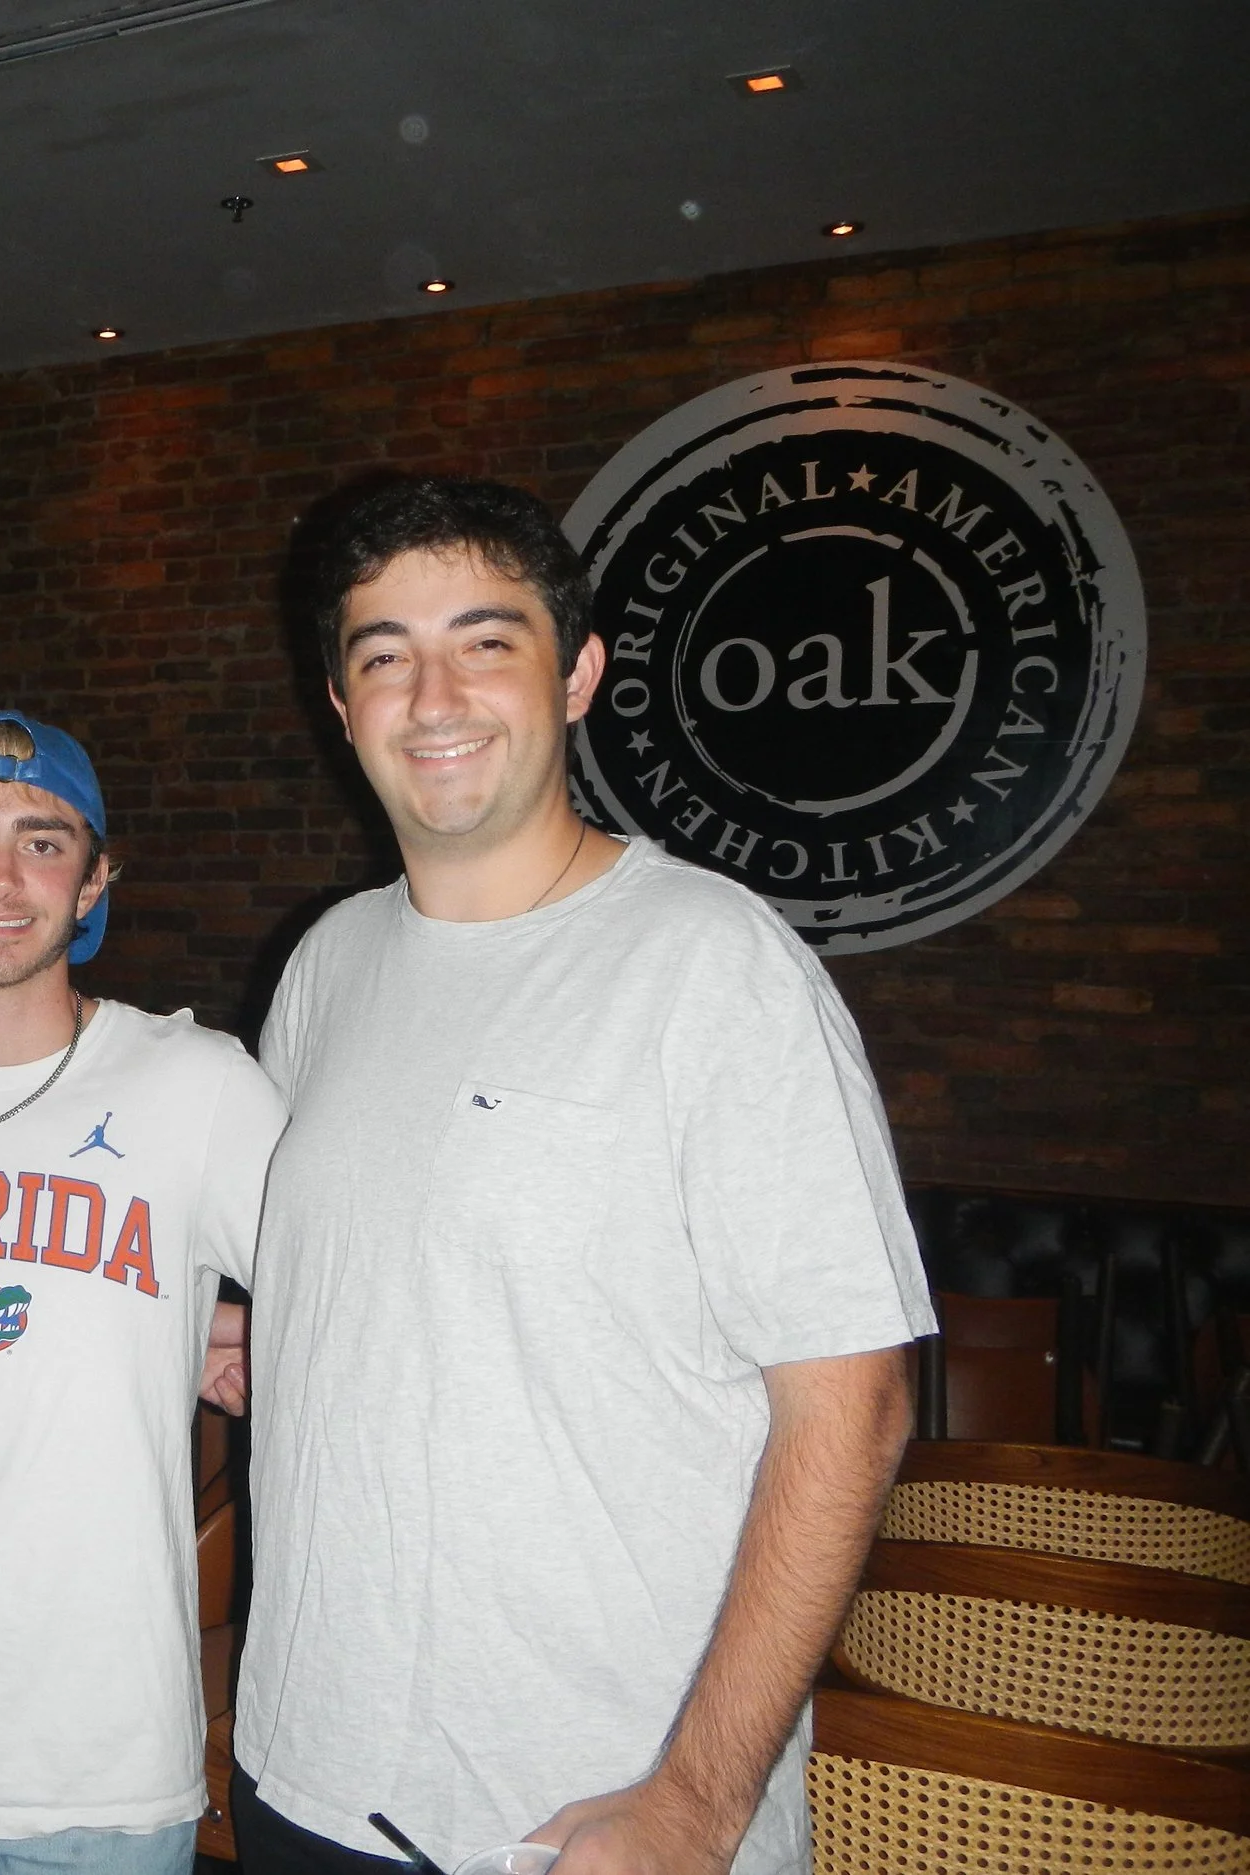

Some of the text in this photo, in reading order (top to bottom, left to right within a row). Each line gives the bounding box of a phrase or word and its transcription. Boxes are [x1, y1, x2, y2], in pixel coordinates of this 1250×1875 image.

[611, 460, 836, 717] ORIGINAL
[699, 576, 957, 712] oak
[879, 468, 1058, 802] AMERICAN
[634, 760, 948, 884] KITCHEN
